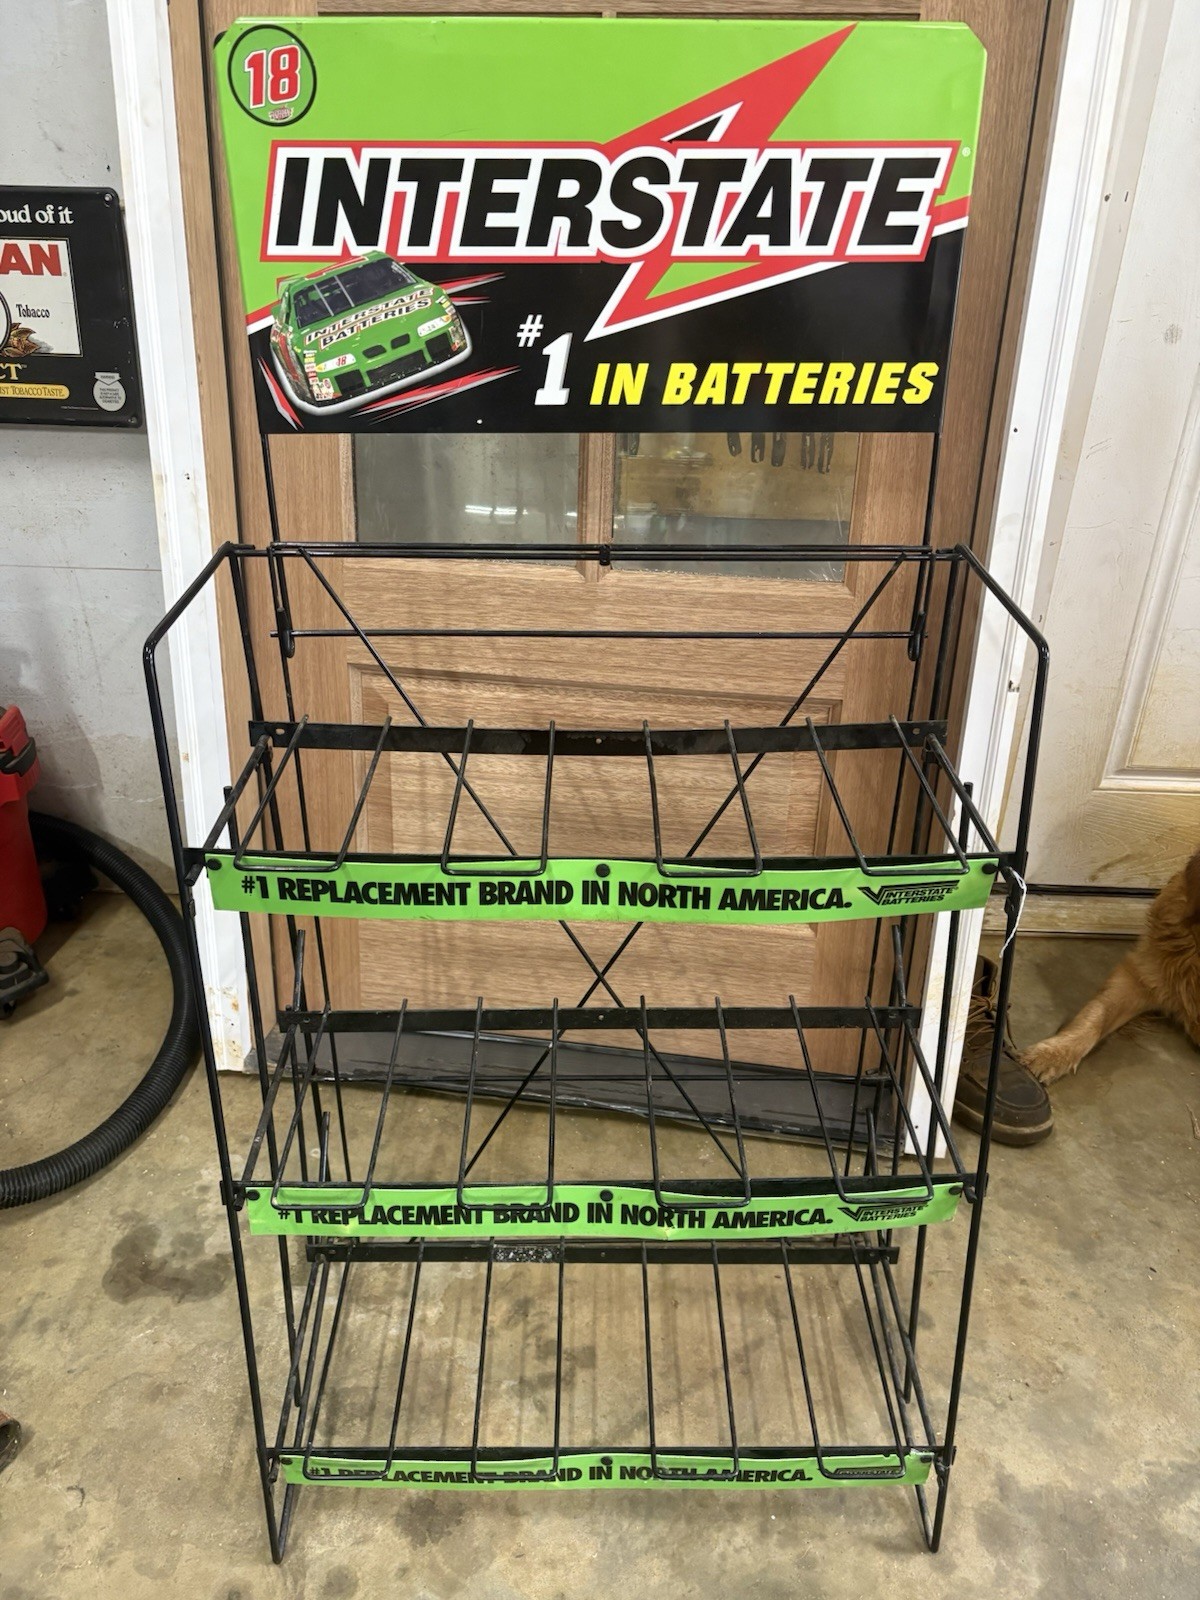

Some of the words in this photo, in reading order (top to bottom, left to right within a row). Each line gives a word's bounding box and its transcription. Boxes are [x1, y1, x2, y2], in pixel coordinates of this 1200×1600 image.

[245, 44, 301, 109] 18
[276, 155, 941, 249] INTERSTATE
[35, 204, 55, 224] of
[58, 206, 74, 224] it
[0, 243, 62, 276] AN
[16, 304, 50, 318] Tobacco
[307, 289, 433, 342] INTERSTATE
[322, 299, 430, 347] BATTERIES
[517, 315, 573, 405] #1
[590, 362, 649, 405] IN
[662, 362, 939, 405] BATTERIES
[10, 386, 42, 396] TOBACCO
[241, 875, 269, 899] #1
[277, 876, 471, 906] REPLACEMENT
[479, 881, 574, 906] BRAND
[582, 880, 610, 906] IN
[618, 881, 711, 910] NORTH
[717, 888, 853, 911] AMERICA.
[881, 895, 945, 906] BATTERIES
[884, 887, 953, 899] INTERSTATE
[278, 1204, 303, 1224] #1
[311, 1205, 483, 1226] REPLACEMENT
[493, 1203, 580, 1225] BRAND
[587, 1203, 613, 1224] IN
[621, 1204, 706, 1229] NORTH
[712, 1208, 834, 1229] AMERICA.
[860, 1210, 917, 1222] BATTERIES
[863, 1205, 924, 1216] INTERSTATE
[589, 1466, 613, 1480] IN
